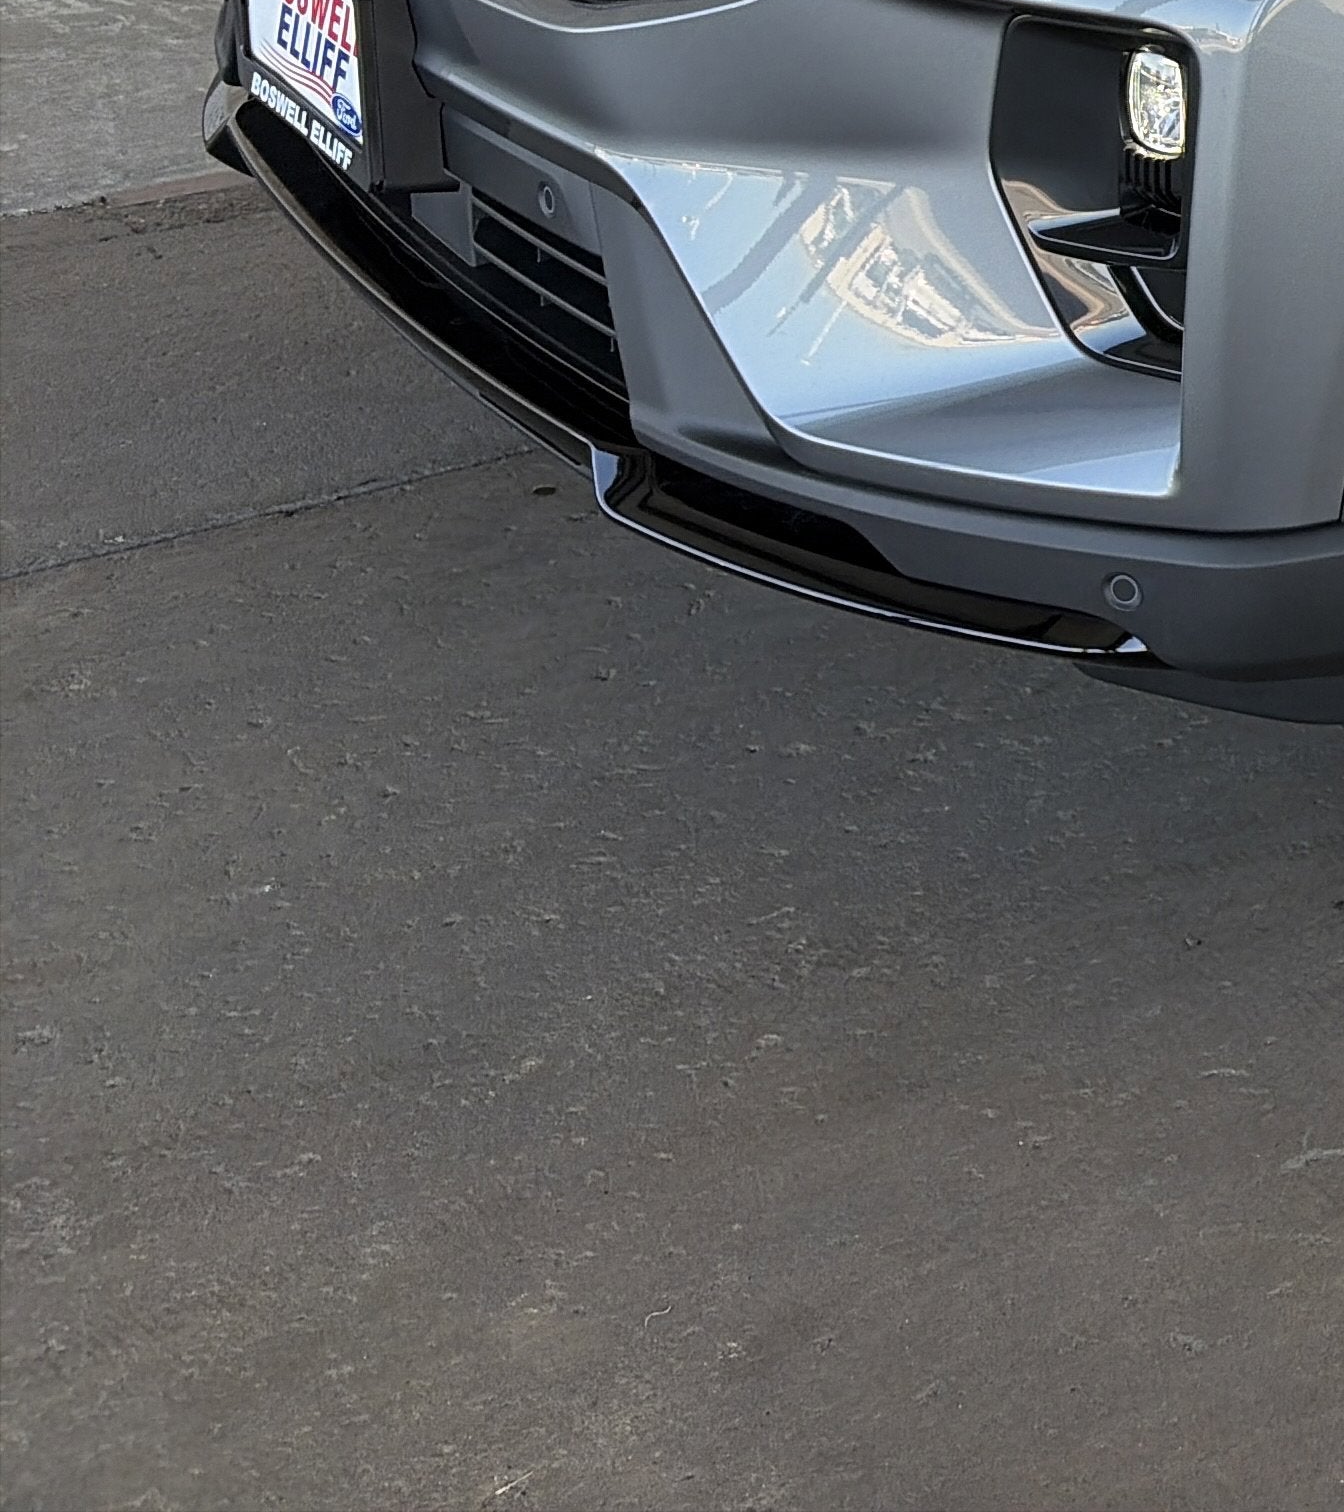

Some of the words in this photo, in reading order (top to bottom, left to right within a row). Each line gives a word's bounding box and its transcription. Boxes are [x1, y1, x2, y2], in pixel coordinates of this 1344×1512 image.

[276, 2, 350, 93] ELLIFF
[250, 71, 310, 138] BOSWELL
[309, 123, 353, 172] ELLIFF
[335, 97, 358, 131] Ford
